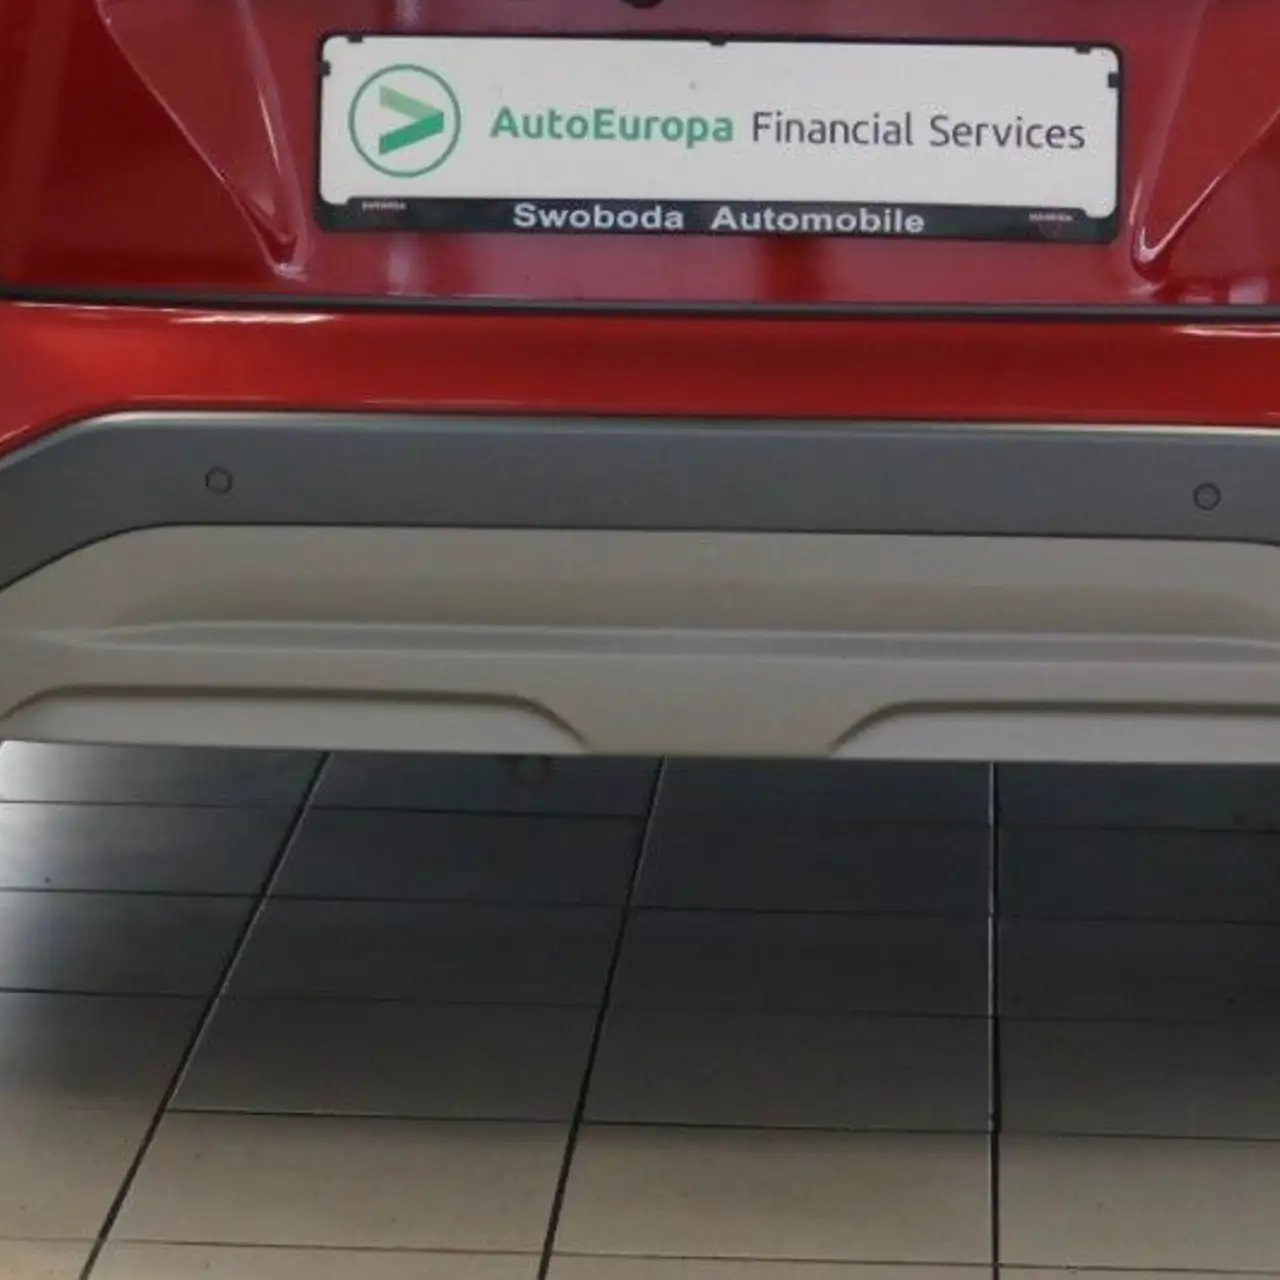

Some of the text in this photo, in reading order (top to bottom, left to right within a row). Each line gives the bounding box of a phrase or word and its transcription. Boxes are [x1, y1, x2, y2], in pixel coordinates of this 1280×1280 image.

[488, 105, 1087, 150] AutoEuropa Financial Services
[513, 202, 926, 234] Swoboda Automobile
